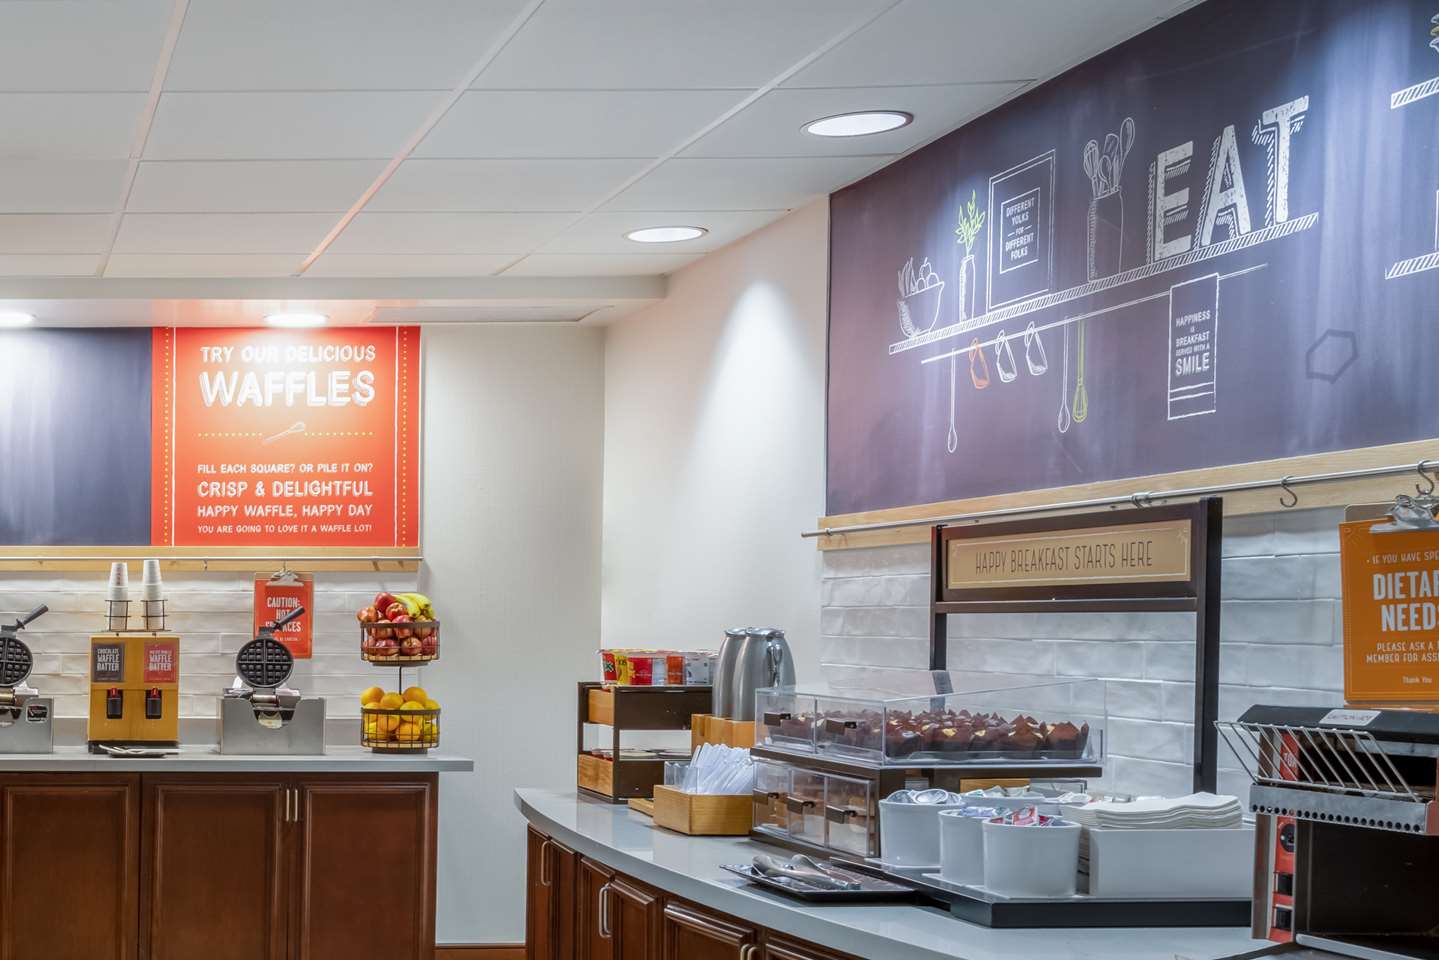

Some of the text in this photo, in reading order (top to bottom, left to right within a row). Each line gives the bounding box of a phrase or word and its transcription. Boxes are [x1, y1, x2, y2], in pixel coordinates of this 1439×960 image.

[1147, 95, 1310, 262] EAT
[1006, 197, 1035, 217] DIFFERENT
[1012, 211, 1029, 225] YOLKS
[1006, 232, 1034, 252] DIFFERENT
[1011, 246, 1028, 261] FOLKS
[1175, 310, 1211, 327] HAPPINESS
[1175, 331, 1210, 347] BREAKFAST
[200, 345, 376, 363] TRY OUR DELICIOUS
[1175, 352, 1210, 376] SMILE
[199, 370, 376, 407] WAFFLES
[197, 463, 373, 474] FILL EACH SQUARE? OR PILE IT ON?
[197, 480, 373, 497] CRISP & DELIGHTFUL
[197, 504, 373, 518] HAPPY WAFFLE, HAPPY DAY
[197, 525, 214, 533] YOU
[217, 525, 233, 533] ARE
[236, 525, 262, 533] GOING
[265, 525, 275, 533] TO
[278, 525, 299, 533] LOVE
[301, 525, 308, 533] IT
[976, 540, 1153, 574] HAPPY BREAKFAST STARTS HERE
[1382, 552, 1398, 563] YOU
[1401, 551, 1421, 562] HAVE
[267, 597, 300, 608] CAUTION:
[1381, 602, 1439, 632] NEED
[1376, 642, 1407, 652] PLEASE
[1410, 641, 1425, 651] ASK
[1427, 641, 1433, 650] A
[97, 654, 120, 663] WAFFLE
[149, 654, 172, 663] WAFFLE
[1366, 653, 1400, 663] MEMBER
[1403, 652, 1418, 663] FOR
[96, 663, 120, 672] BATTER
[149, 663, 172, 672] BATTER
